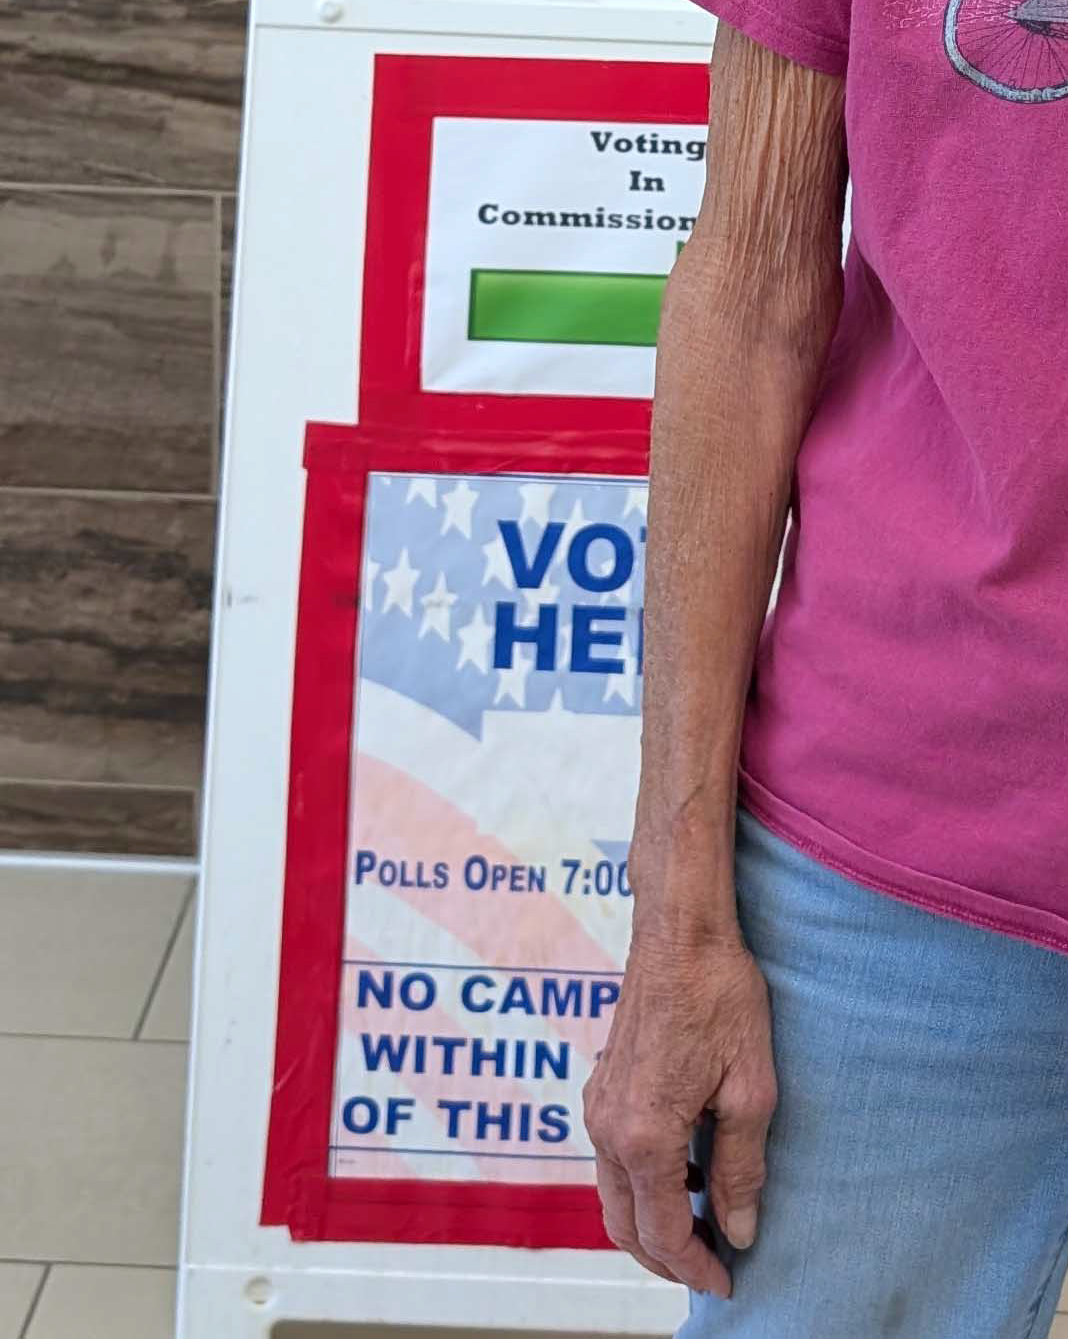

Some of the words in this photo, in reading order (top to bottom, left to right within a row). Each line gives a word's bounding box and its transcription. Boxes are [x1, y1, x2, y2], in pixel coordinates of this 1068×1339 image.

[590, 131, 706, 162] Voting
[629, 169, 666, 192] In
[496, 519, 647, 594] VO
[491, 600, 643, 677] HE
[357, 970, 437, 1012] NO
[460, 975, 620, 1019] CAMP
[360, 1033, 570, 1081] WITHIN
[342, 1095, 416, 1136] OF
[437, 1099, 571, 1144] THIS
